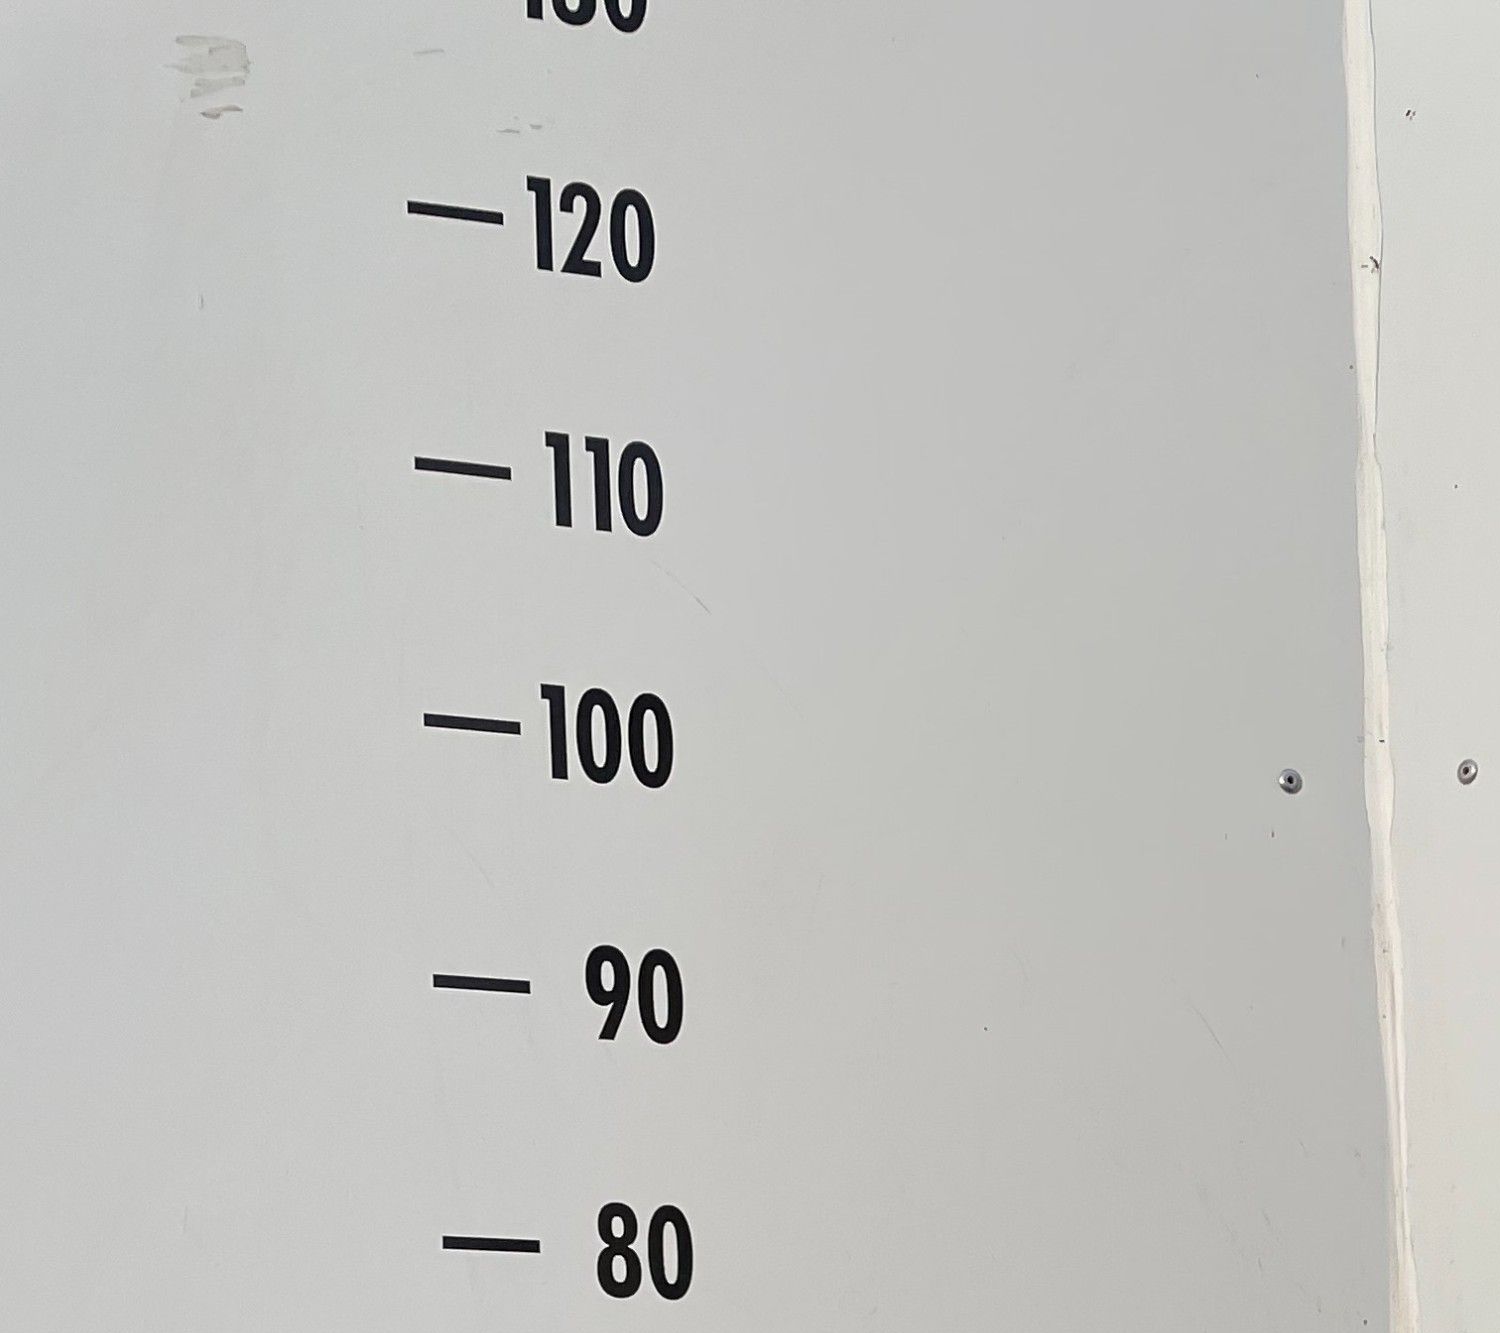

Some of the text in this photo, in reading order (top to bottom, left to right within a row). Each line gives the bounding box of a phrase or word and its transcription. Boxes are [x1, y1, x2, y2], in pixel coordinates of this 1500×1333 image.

[526, 175, 655, 283] 120
[544, 431, 664, 537] 110
[540, 683, 674, 789] 100
[585, 945, 684, 1045] 90
[597, 1202, 693, 1301] 80
